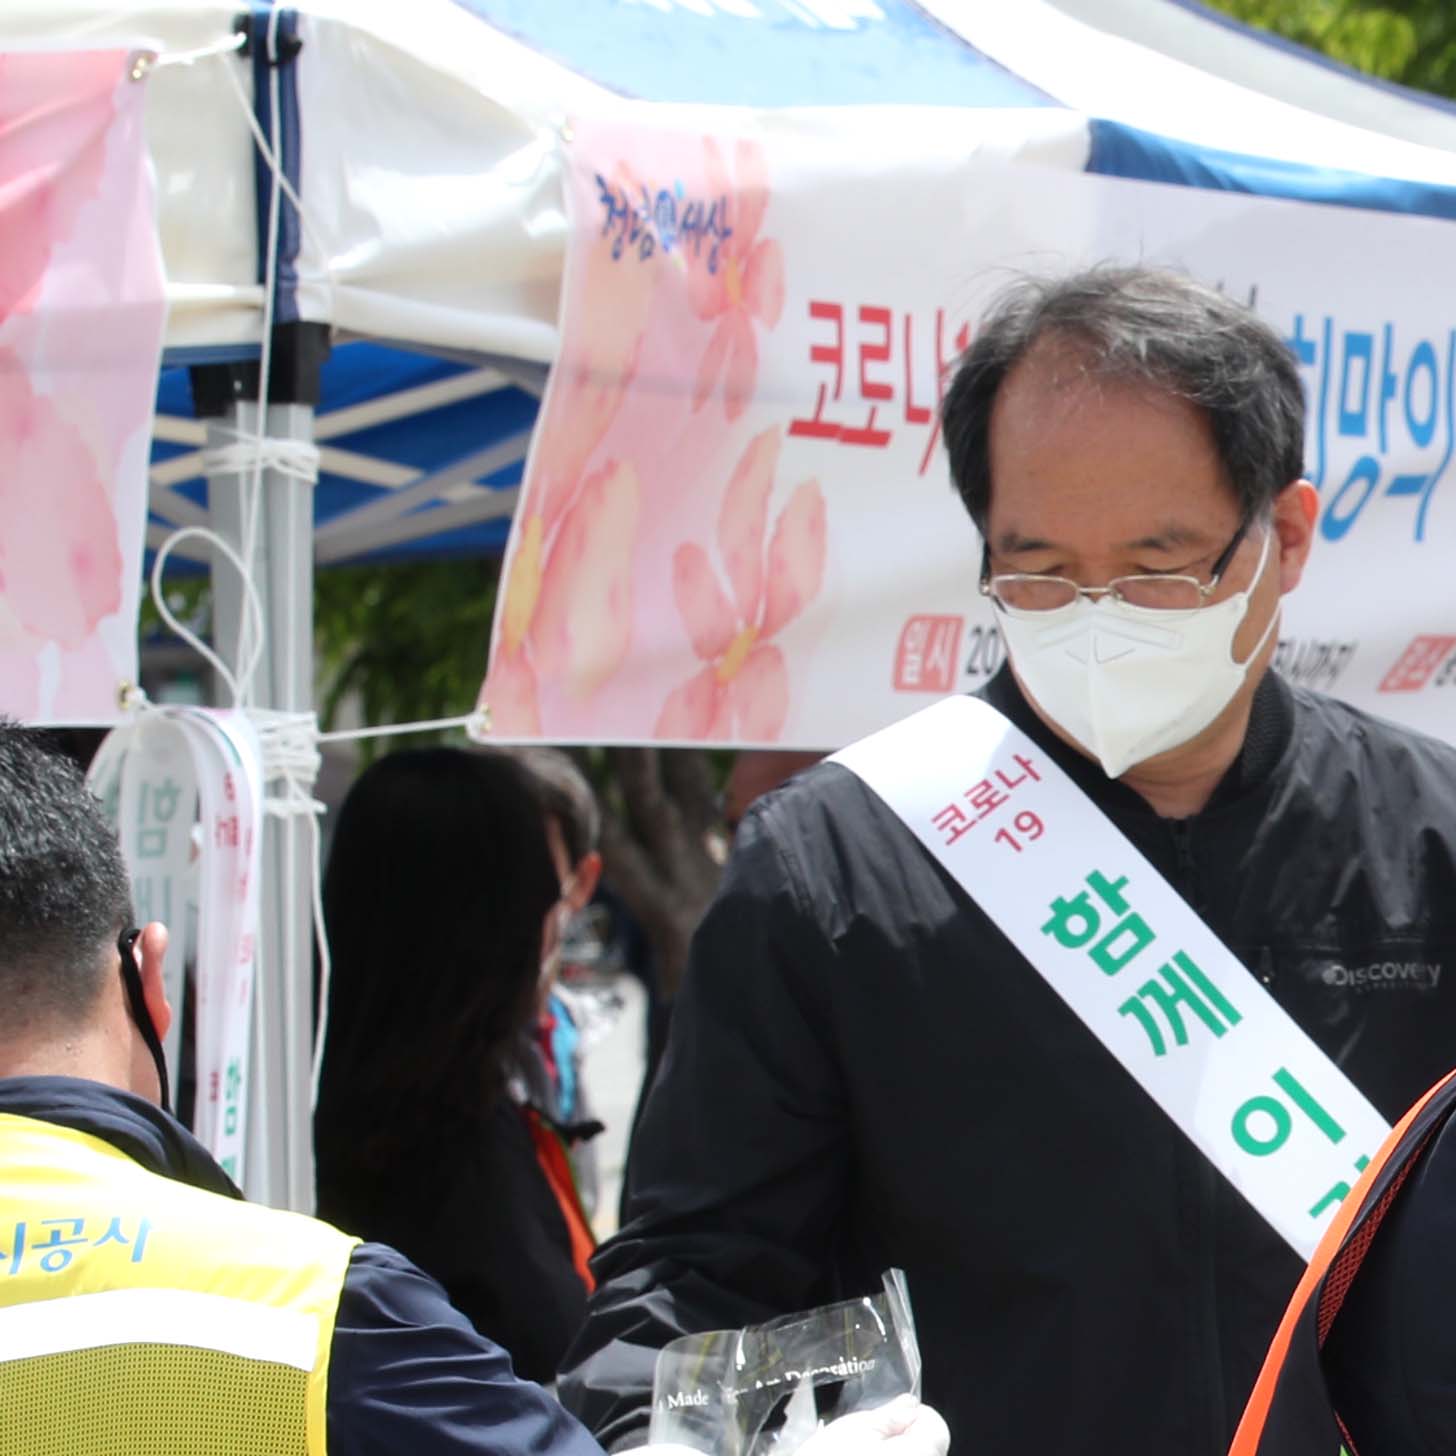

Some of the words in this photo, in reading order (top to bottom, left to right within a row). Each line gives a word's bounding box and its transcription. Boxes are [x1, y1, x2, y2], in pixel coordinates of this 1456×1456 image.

[788, 300, 972, 477] 코로나
[931, 754, 1042, 846] 코로나
[994, 810, 1045, 852] 19
[1040, 869, 1243, 1057] 함께
